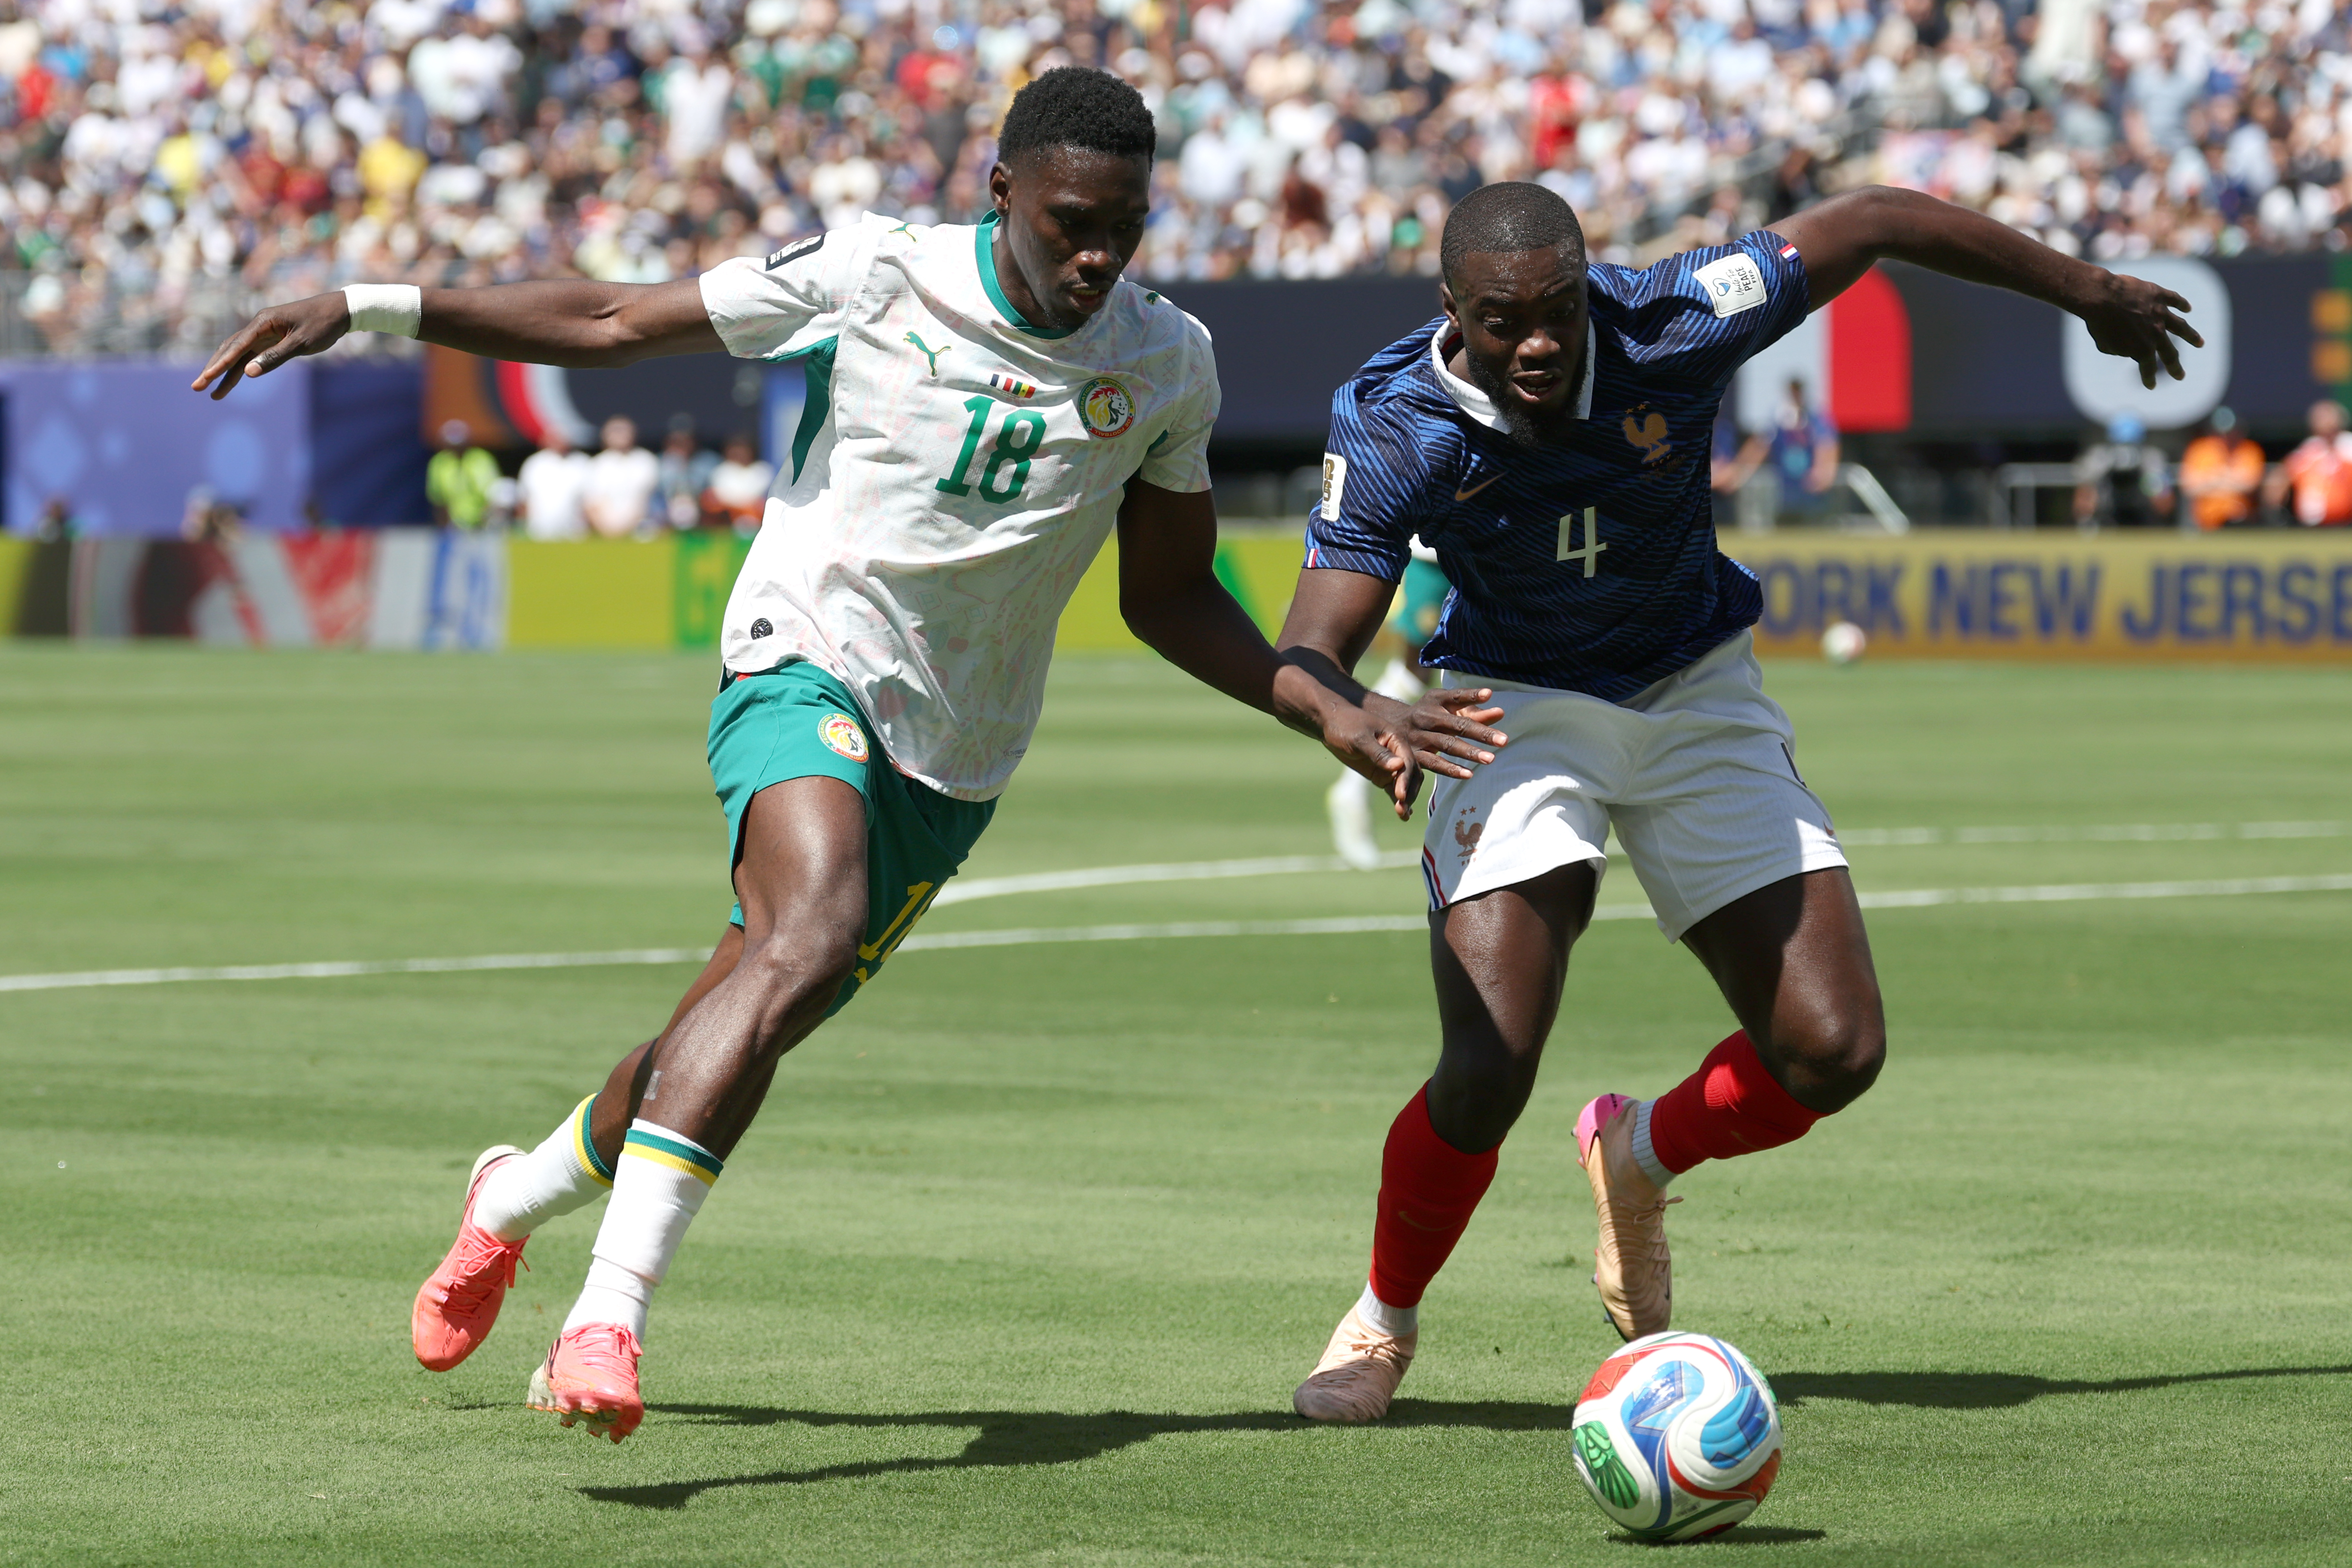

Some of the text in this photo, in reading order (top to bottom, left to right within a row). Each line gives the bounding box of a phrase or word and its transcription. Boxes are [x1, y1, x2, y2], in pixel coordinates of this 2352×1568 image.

[1735, 266, 1753, 291] PEACE
[935, 395, 1047, 504] 18
[1094, 427, 1125, 437] FOOTBALL
[1557, 506, 1608, 578] 4
[1752, 561, 1906, 638] ORK
[1929, 561, 2100, 639] NEW
[442, 1327, 454, 1357] F50
